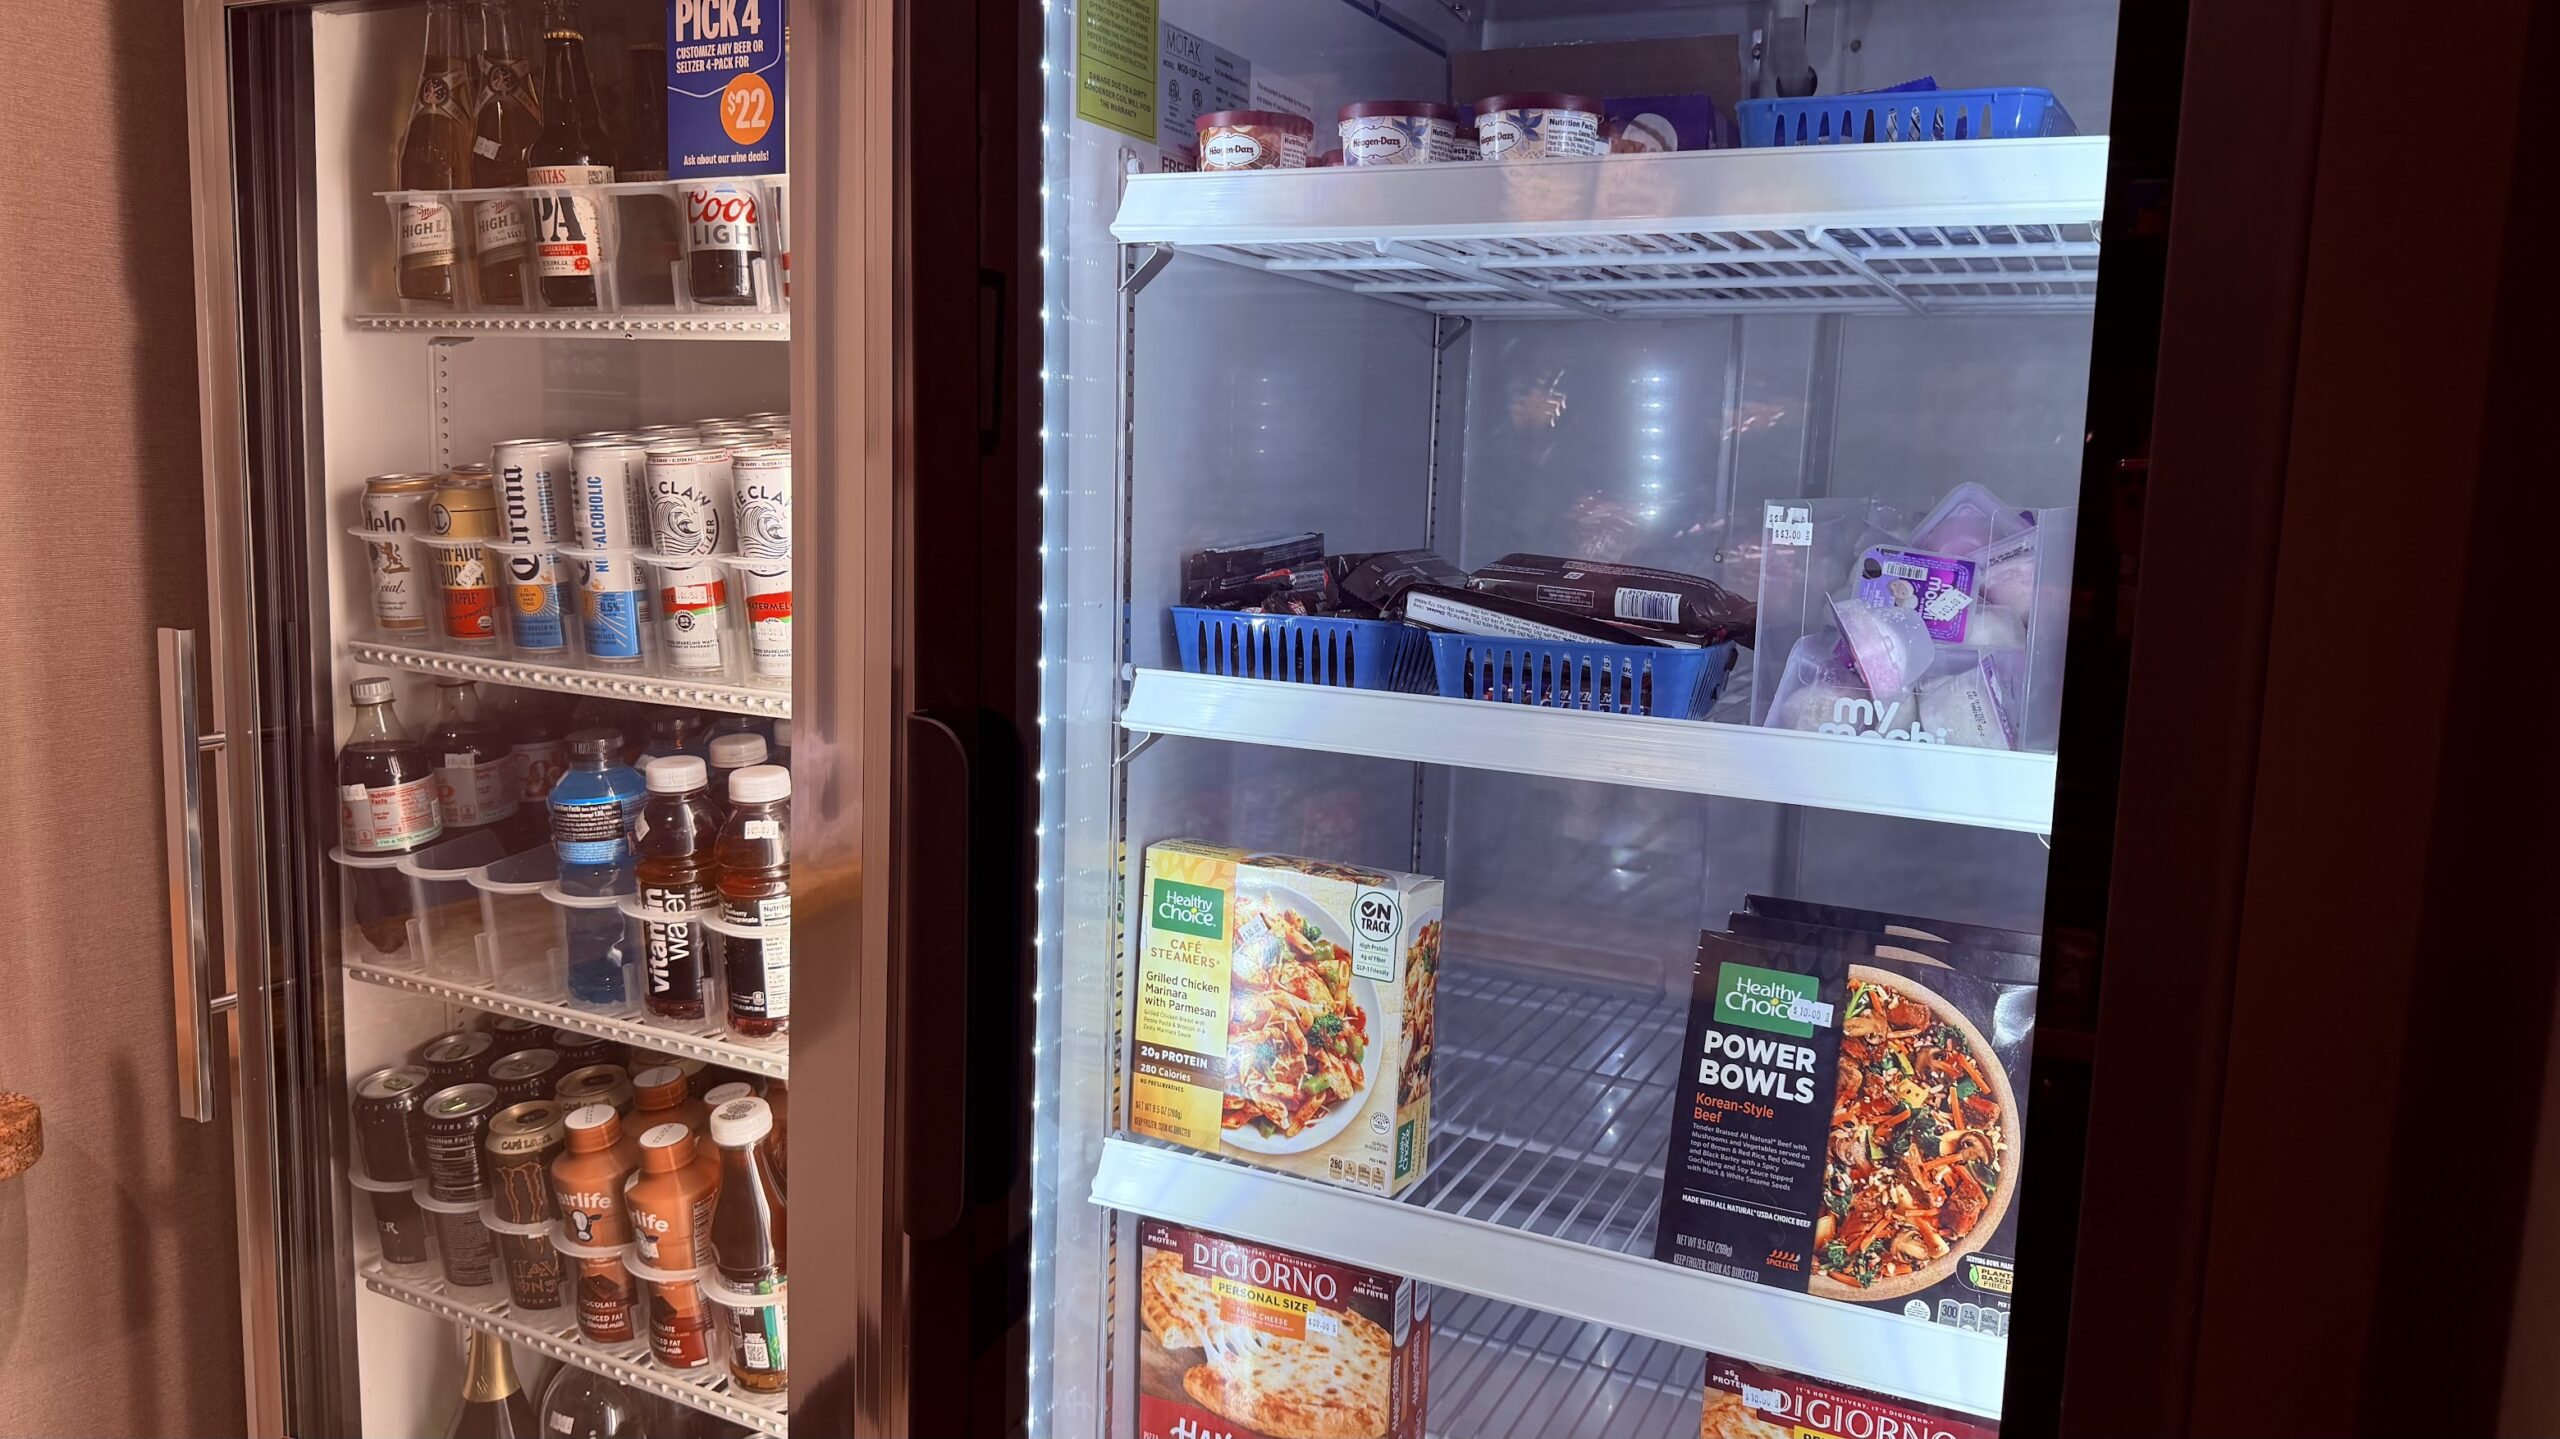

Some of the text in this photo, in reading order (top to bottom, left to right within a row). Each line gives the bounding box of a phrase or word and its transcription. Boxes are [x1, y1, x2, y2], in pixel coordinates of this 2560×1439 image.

[675, 0, 761, 42] PICK 4
[676, 40, 764, 59] CUSTOMIZE ANY BEER OR
[1166, 30, 1201, 64] MOTAK
[676, 55, 749, 73] SELTZER 4-PACK FOR
[1085, 81, 1140, 109] CONDENSER WILL
[1089, 72, 1147, 99] DAMAGE DUE TO DIRTY
[727, 87, 766, 128] $22
[1100, 99, 1136, 118] THE WARRANTY
[1549, 118, 1580, 128] Nutrition
[684, 150, 769, 165] Ask about our wine deals!
[480, 216, 508, 234] HIGH
[531, 190, 587, 242] PA
[402, 222, 433, 239] HIGH
[693, 224, 760, 246] LIGH
[659, 481, 711, 507] CLAW
[536, 471, 562, 566] N-ALCOHOLIC
[587, 476, 609, 573] NO-ALCOHOLIC
[1833, 697, 1900, 734] my
[1167, 890, 1212, 912] Healthy
[1361, 901, 1391, 920] ON
[664, 888, 690, 962] waer
[1361, 918, 1390, 933] TRACK
[1171, 939, 1201, 953] CAFÉ
[1371, 944, 1388, 952] Protein
[1151, 947, 1215, 968] STEAMERS
[1146, 983, 1187, 999] Marinara
[1147, 971, 1220, 993] Grilled Chicken
[1737, 977, 1802, 1004] Healthy
[1145, 996, 1216, 1017] with Parmesan
[1725, 992, 1789, 1018] Choic
[1141, 1046, 1208, 1069] 20g PROTEIN
[1704, 1030, 1816, 1073] POWER
[1141, 1064, 1191, 1082] 280 Calories
[1698, 1059, 1815, 1104] BOWLS
[1148, 1079, 1184, 1092] PRESERVATIVES
[1135, 1101, 1151, 1111] NET WT
[1693, 1106, 1722, 1124] Beef
[1695, 1092, 1774, 1118] Korean-Style
[1173, 1125, 1191, 1138] DIRECTED
[1693, 1122, 1714, 1133] Tender
[1716, 1127, 1738, 1137] Braised
[1793, 1143, 1808, 1151] with
[1690, 1140, 1701, 1148] top
[1711, 1144, 1730, 1153] Brown
[1738, 1149, 1750, 1157] Red
[1752, 1152, 1766, 1160] Rice,
[1767, 1155, 1780, 1163] Red
[1782, 1158, 1805, 1168] Quinoa
[1692, 1131, 1728, 1144] Mushrooms
[1743, 1141, 1777, 1154] Vegetables
[1779, 1149, 1800, 1158] served
[1330, 1158, 1342, 1170] 280
[1688, 1154, 1721, 1168] Gochujang
[1737, 1166, 1748, 1175] Soy
[1750, 1169, 1768, 1178] Sauce
[1770, 1172, 1793, 1183] topped
[1689, 1147, 1701, 1156] and
[1703, 1150, 1719, 1159] Black
[1720, 1153, 1740, 1164] Barley
[1741, 1158, 1755, 1166] with
[1762, 1163, 1779, 1172] Spicy
[1687, 1164, 1701, 1173] with
[1702, 1167, 1719, 1176] Black
[1726, 1172, 1745, 1182] White
[1746, 1176, 1770, 1187] Sesame
[1772, 1181, 1790, 1191] Seeds
[630, 1209, 669, 1233] rlife
[1682, 1194, 1699, 1204] MADE
[1700, 1199, 1715, 1207] WITH
[1715, 1201, 1726, 1210] ALL
[1756, 1210, 1773, 1220] USDA
[1773, 1214, 1795, 1225] CHOICE
[1796, 1219, 1811, 1228] BEEF
[1148, 1234, 1178, 1248] PROTEIN
[1676, 1233, 1733, 1257] NET WT 9.5 OZ (269g)
[1673, 1253, 1759, 1282] KEEP COOK AS DIRECTED
[1766, 1257, 1799, 1271] SPICE LEVEL
[1966, 1255, 2014, 1271] SERVING BOWL MADE
[1981, 1275, 2011, 1285] BASED
[1982, 1269, 2014, 1279] PLANT-
[1353, 1286, 1389, 1300] AIR FRYER
[1983, 1281, 2008, 1291] FIBER
[1218, 1282, 1308, 1312] PERSONAL SIZE
[611, 1312, 623, 1320] FAT
[1236, 1306, 1288, 1326] FOUR CHEESE
[1942, 1305, 1958, 1318] 300
[1712, 1375, 1750, 1388] PROTEIN
[1796, 1386, 1810, 1394] IT'S
[1813, 1391, 1828, 1399] NOT
